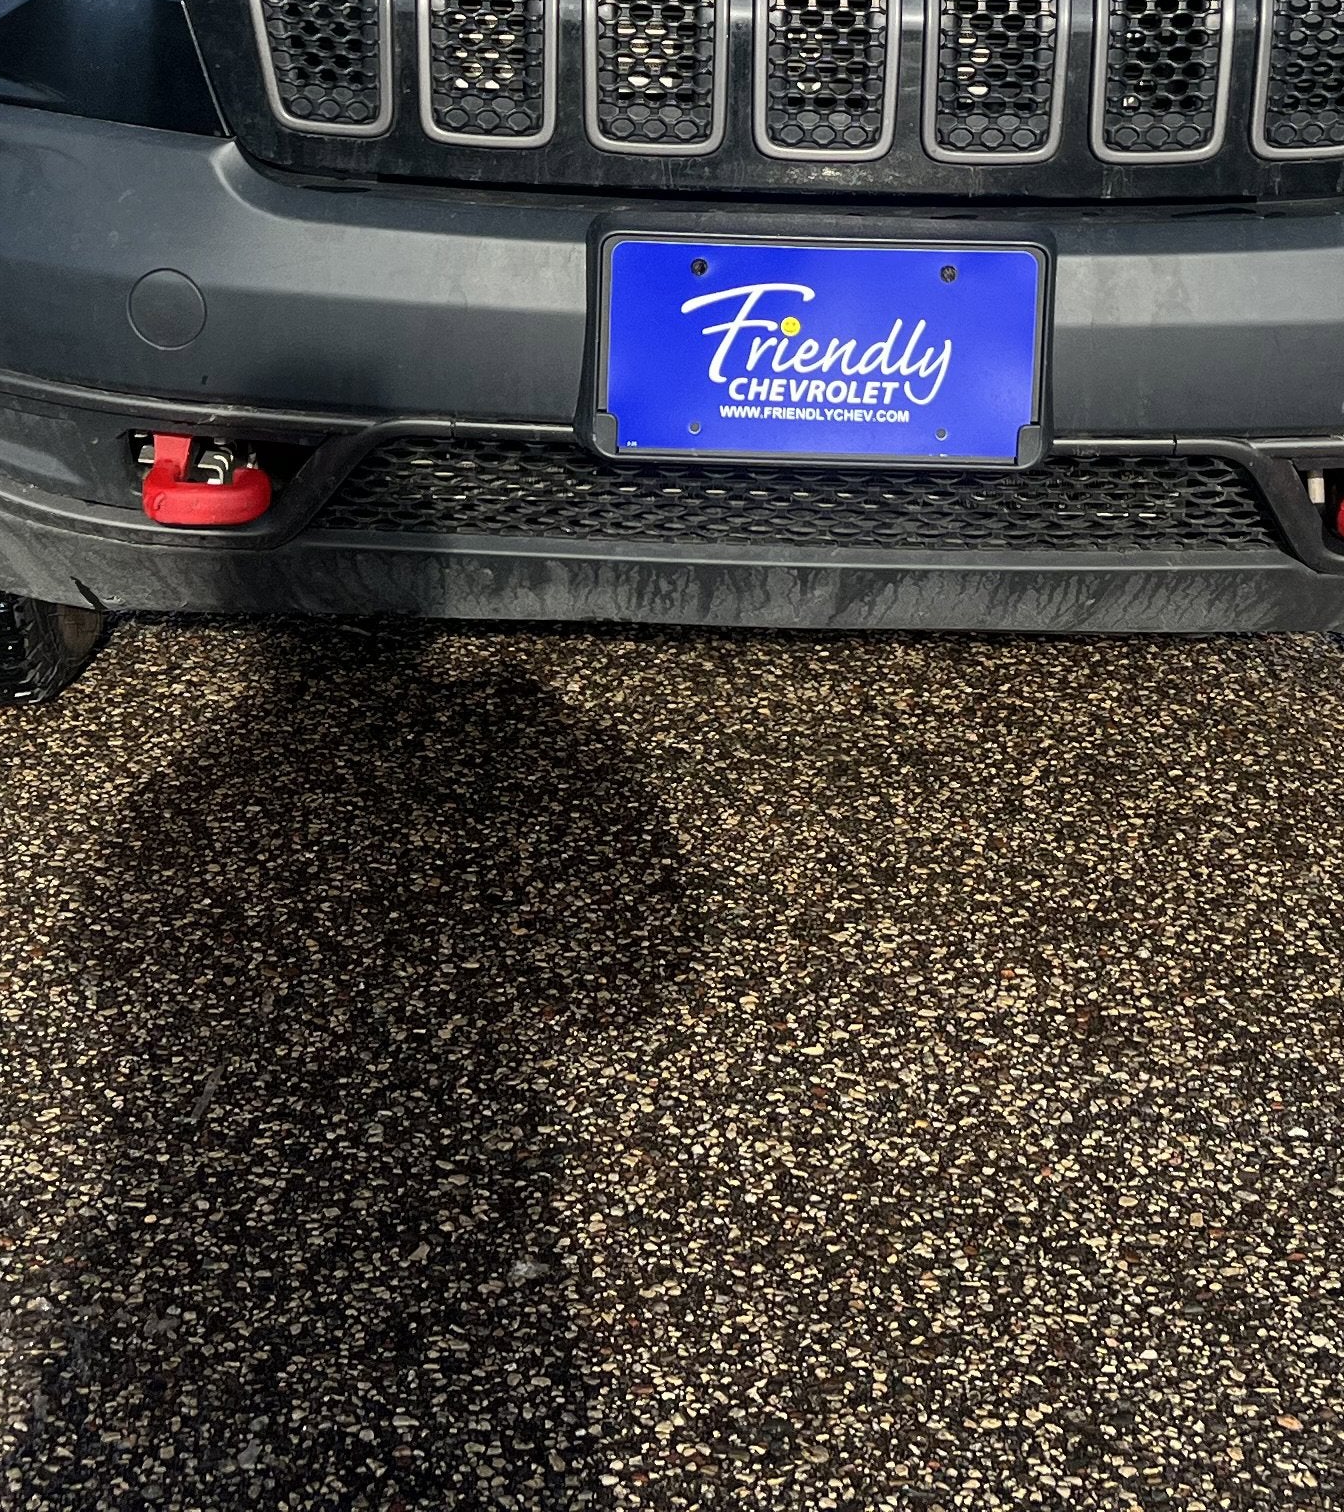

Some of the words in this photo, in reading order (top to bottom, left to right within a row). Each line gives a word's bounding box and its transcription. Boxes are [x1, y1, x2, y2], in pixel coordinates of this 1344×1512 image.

[680, 283, 952, 406] Friendly
[728, 377, 901, 405] CHEVROLET
[719, 405, 910, 423] WWW.FRIENDLYCHEV.COM
